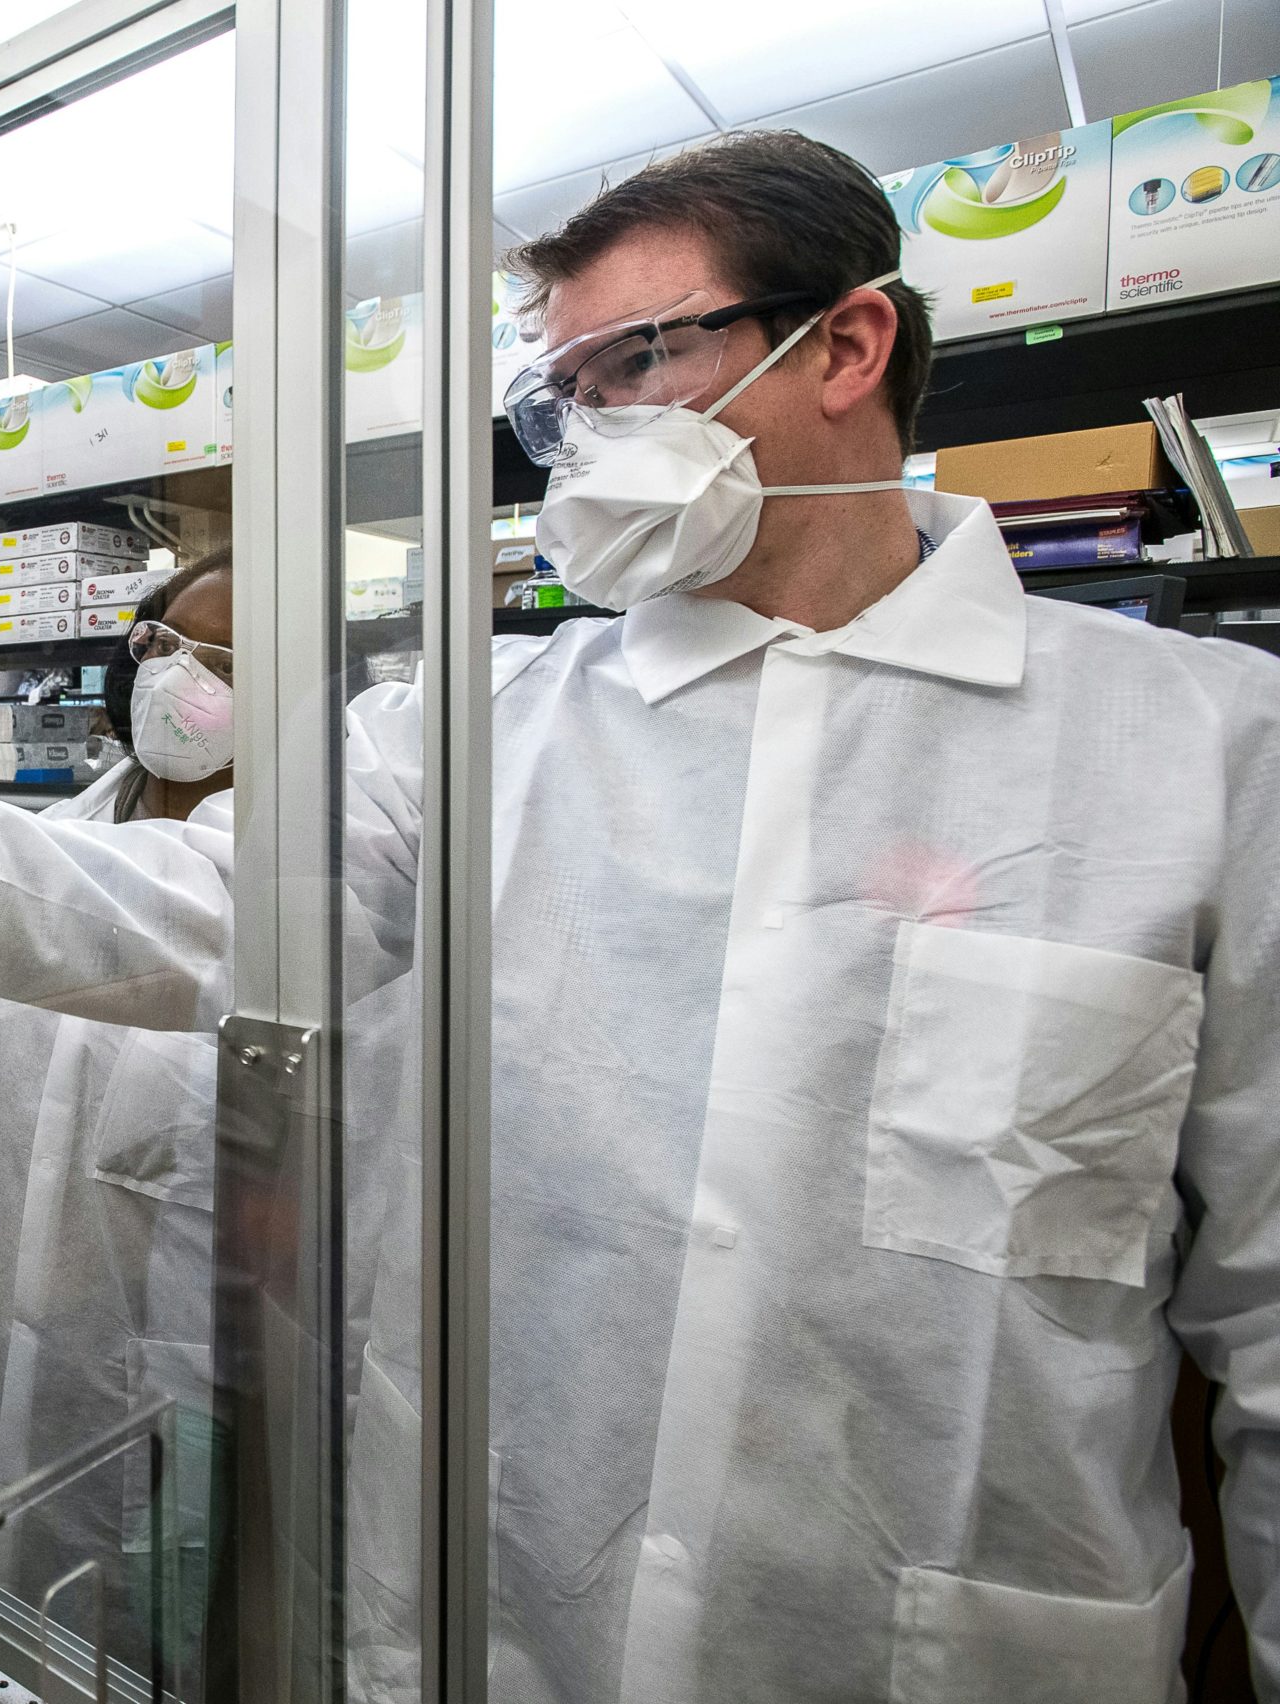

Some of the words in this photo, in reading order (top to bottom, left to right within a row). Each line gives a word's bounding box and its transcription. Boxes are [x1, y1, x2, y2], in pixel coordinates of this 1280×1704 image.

[1009, 145, 1076, 169] ClipTip
[1120, 268, 1180, 288] thermo
[1120, 279, 1183, 300] scientific
[989, 297, 1088, 319] www.thermofisher.com/cliptip
